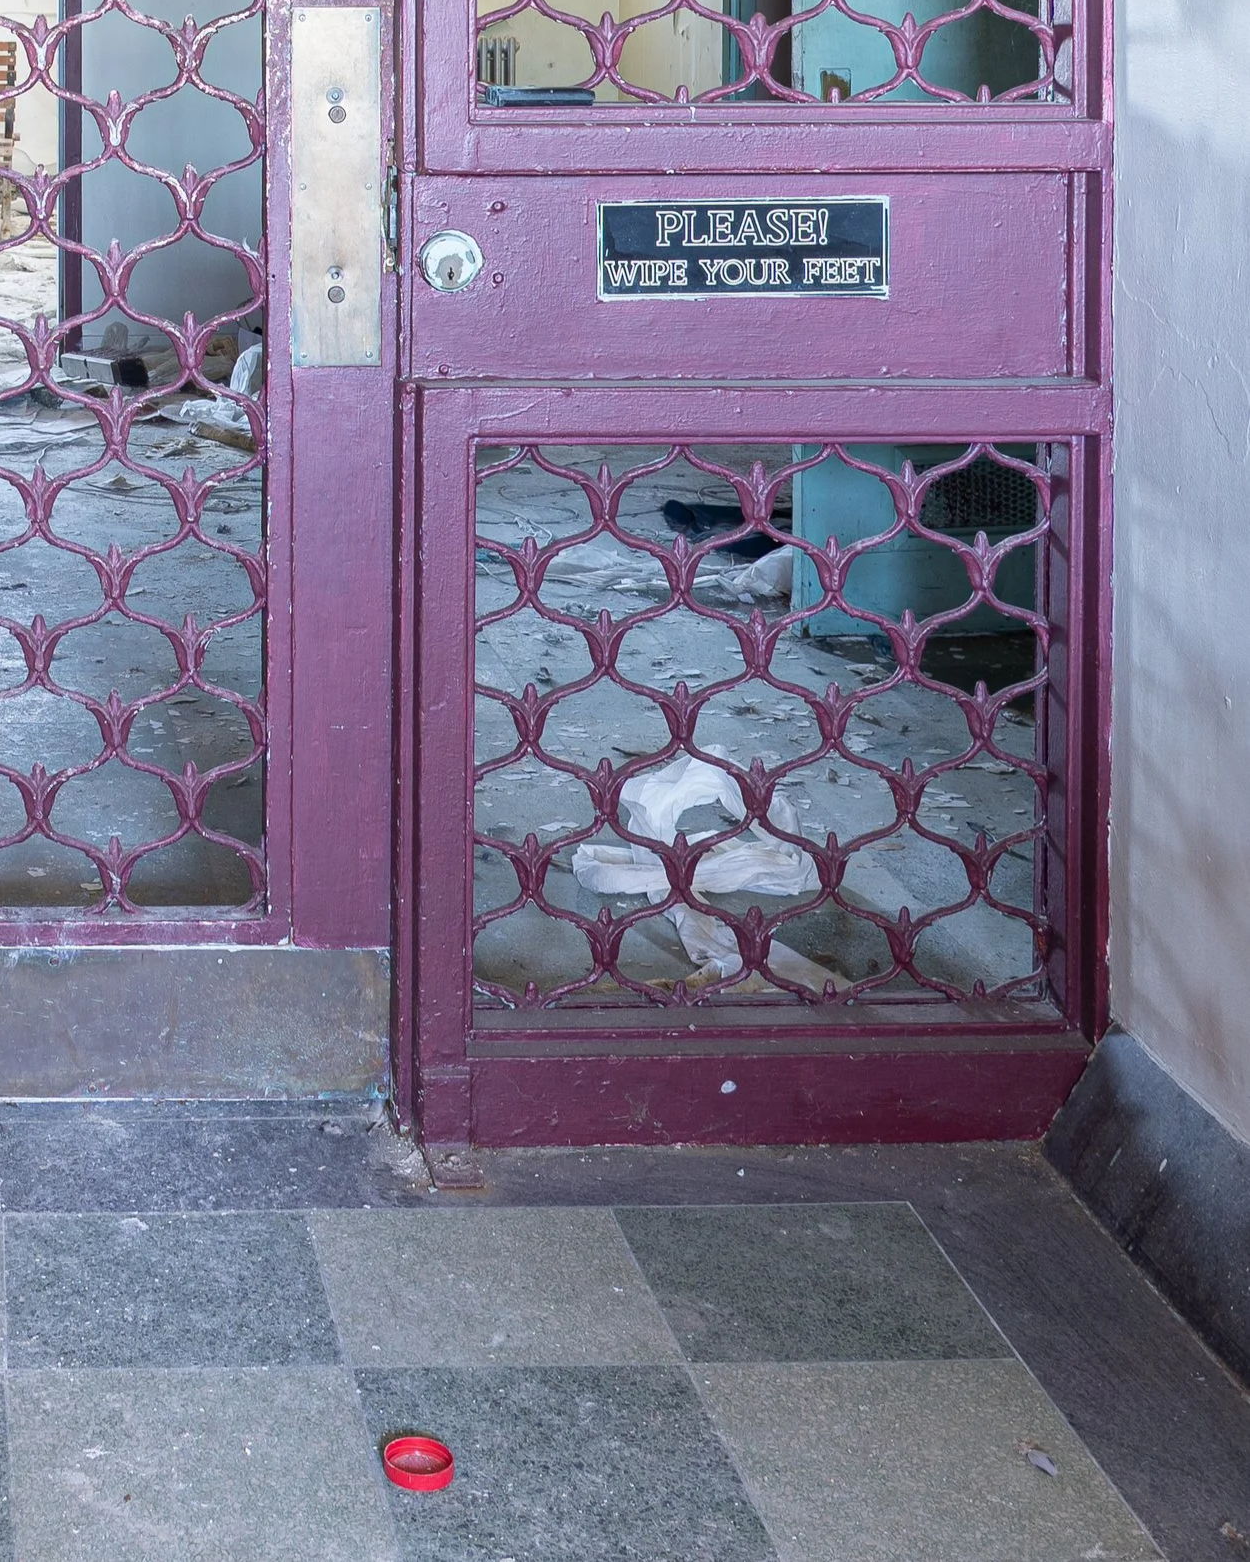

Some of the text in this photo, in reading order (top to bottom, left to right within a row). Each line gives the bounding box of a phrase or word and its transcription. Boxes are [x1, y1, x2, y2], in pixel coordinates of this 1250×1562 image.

[656, 208, 830, 247] PLEASE!
[604, 256, 881, 286] WIPE YOUR FEET
